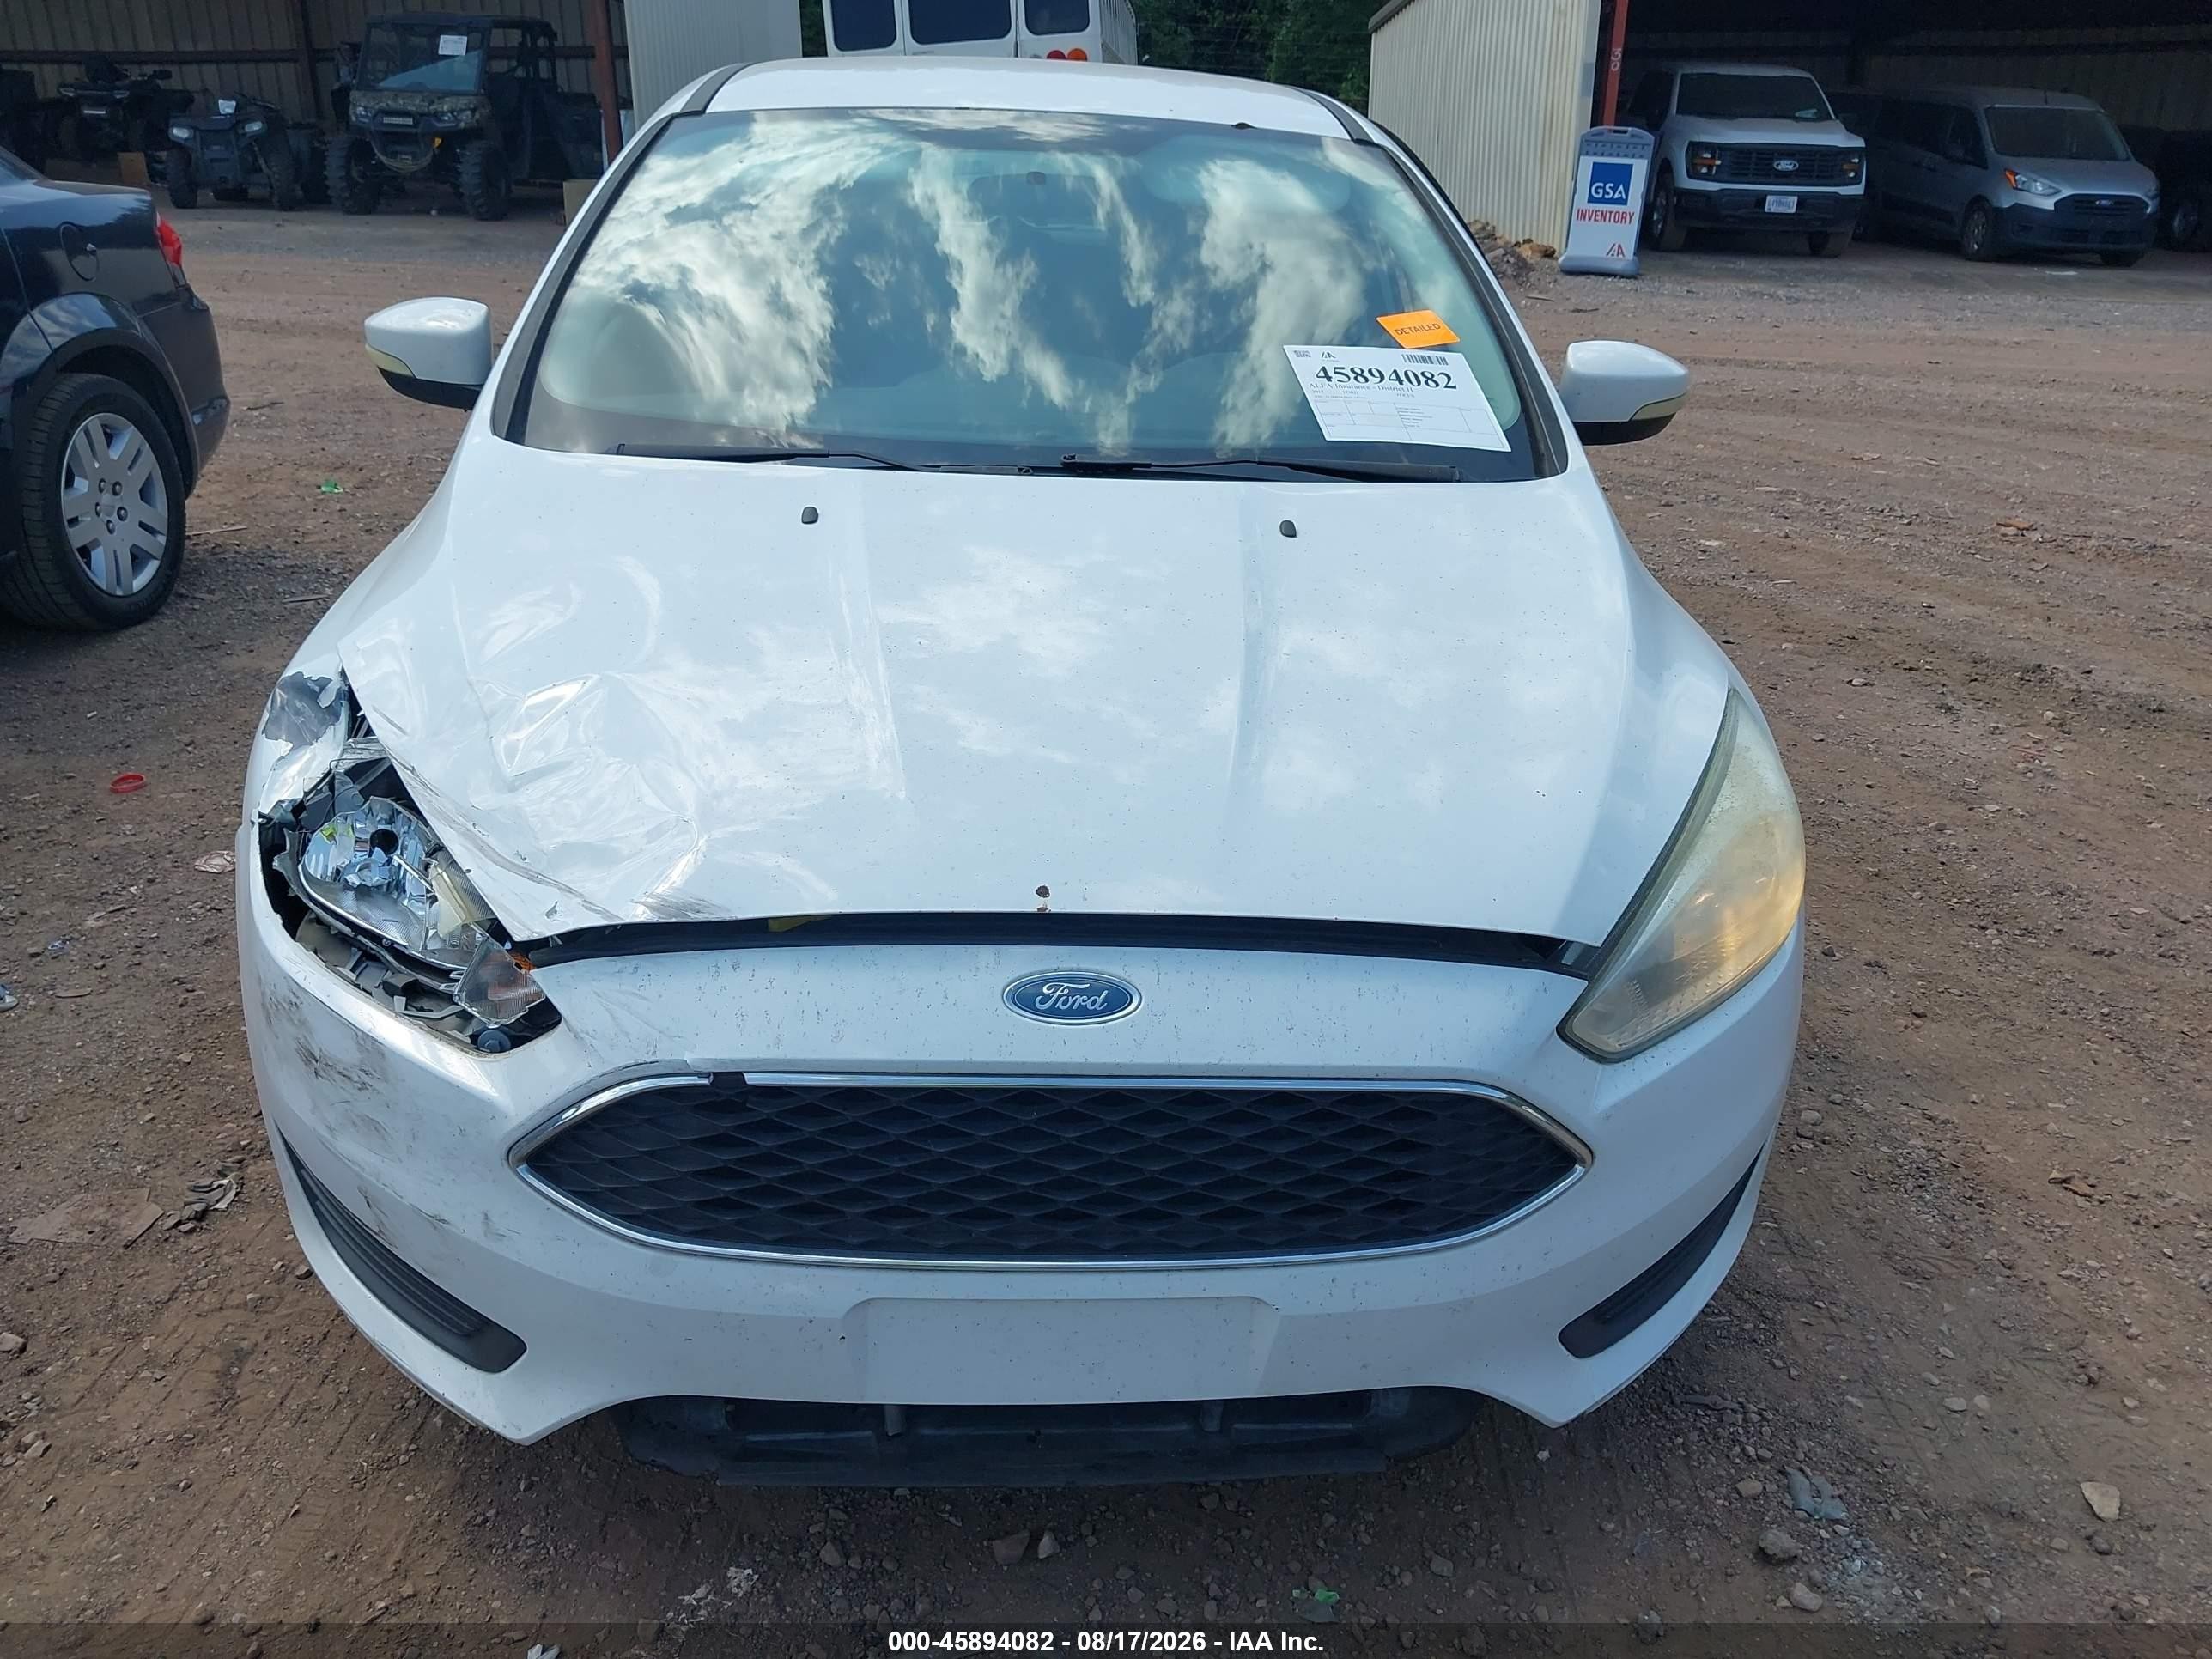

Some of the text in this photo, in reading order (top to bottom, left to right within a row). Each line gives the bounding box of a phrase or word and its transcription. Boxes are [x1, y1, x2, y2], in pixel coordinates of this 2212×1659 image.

[1591, 182, 1626, 199] GSA
[1576, 208, 1635, 225] INVENTORY
[1394, 323, 1441, 336] DETAILED
[1316, 366, 1457, 390] 45894082
[1035, 982, 1109, 1011] Ford
